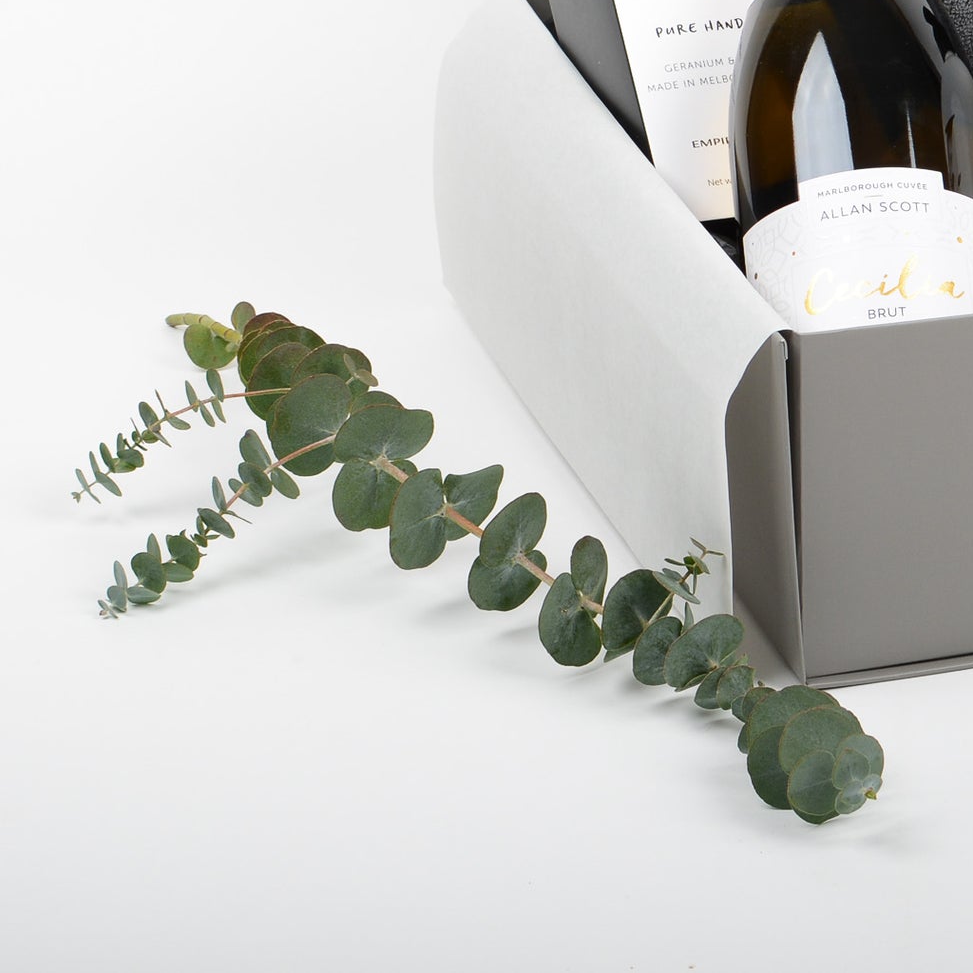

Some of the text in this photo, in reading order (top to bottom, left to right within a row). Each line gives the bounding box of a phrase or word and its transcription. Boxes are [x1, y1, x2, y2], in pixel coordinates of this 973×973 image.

[655, 17, 744, 39] PURE HAND
[664, 58, 725, 73] GERANIUM
[647, 80, 680, 93] MADE
[683, 77, 696, 88] IN
[707, 178, 723, 187] Net
[817, 182, 894, 199] MARLBOROUGH
[820, 201, 930, 222] ALLAN SCOTT
[804, 254, 966, 316] Cecilia
[867, 306, 907, 320] BRUT
